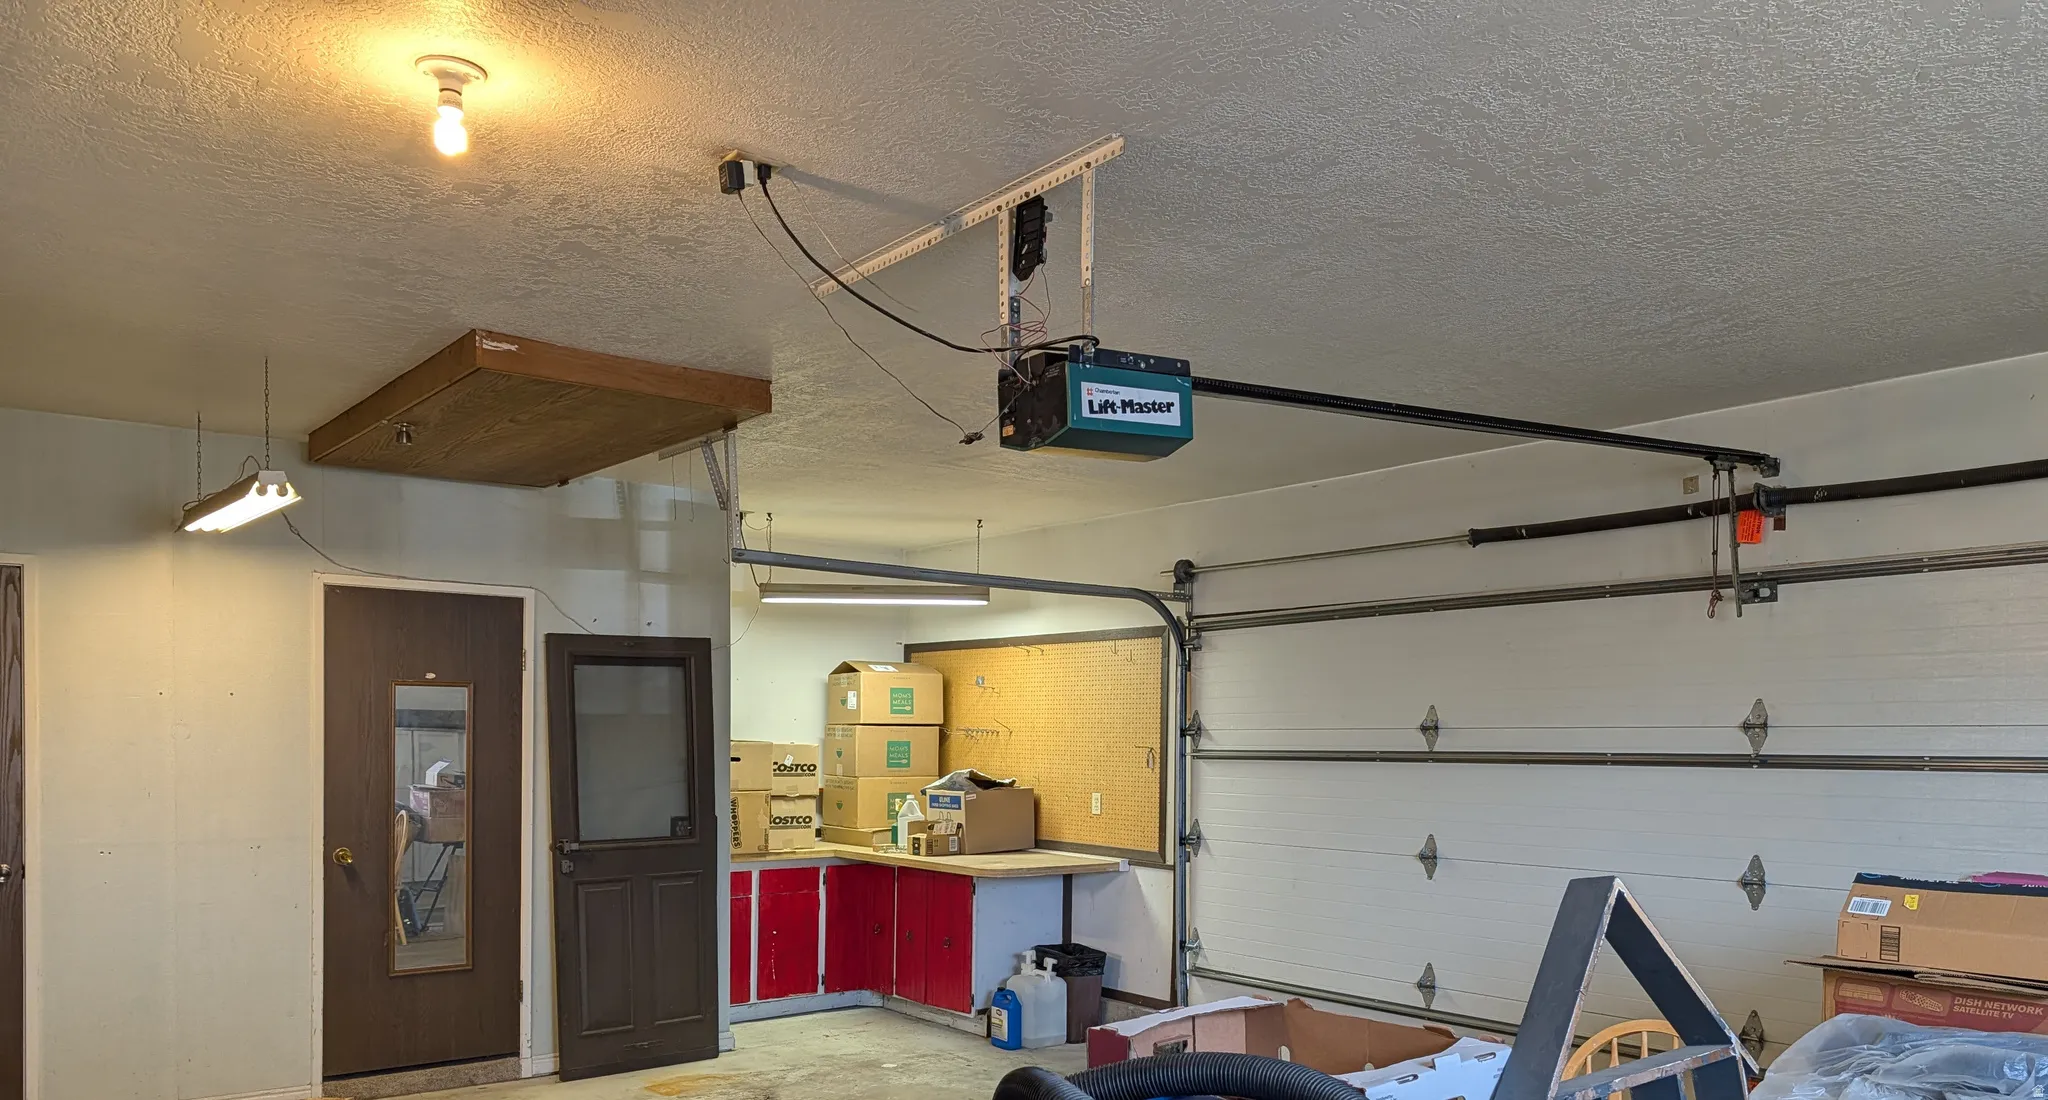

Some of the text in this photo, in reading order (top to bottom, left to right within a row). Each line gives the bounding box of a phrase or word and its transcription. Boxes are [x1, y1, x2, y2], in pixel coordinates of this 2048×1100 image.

[1088, 399, 1175, 415] Lift-Master
[730, 798, 741, 847] WHOPPERS
[772, 815, 812, 825] OSTCO
[1953, 1005, 2015, 1019] SATELLITE TV
[1954, 997, 2044, 1016] DISH NETWORK
